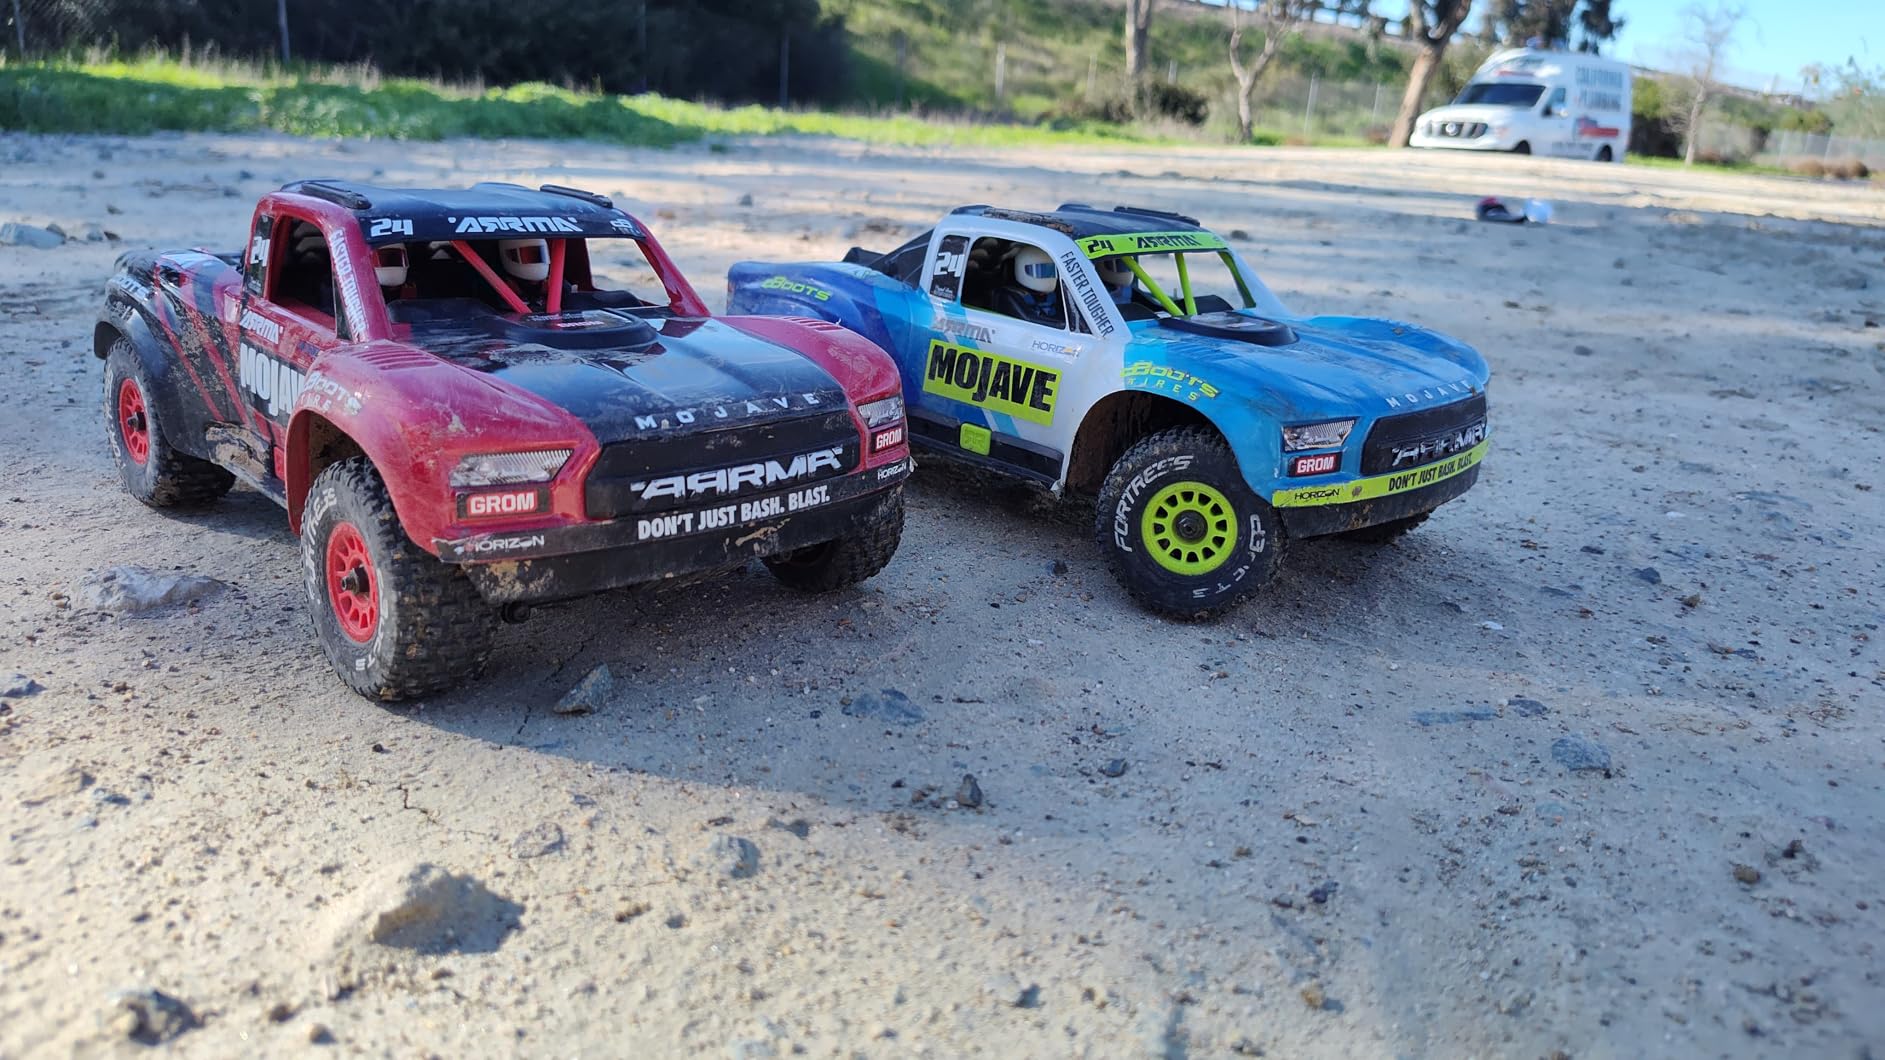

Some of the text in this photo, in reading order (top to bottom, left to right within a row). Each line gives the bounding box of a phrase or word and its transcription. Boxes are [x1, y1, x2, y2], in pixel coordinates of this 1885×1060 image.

[370, 218, 414, 237] 24
[250, 236, 271, 267] 24
[1087, 240, 1115, 253] 24
[934, 251, 965, 277] 24
[240, 342, 306, 416] MOJAV
[928, 344, 1057, 412] MOJAVE
[1128, 377, 1198, 401] TIRES
[634, 393, 820, 430] MOJAVE
[876, 428, 902, 449] GROM
[1296, 456, 1334, 473] GROM
[1388, 472, 1418, 491] DON'T
[1418, 466, 1438, 484] JUST
[470, 492, 534, 514] GROM
[1294, 488, 1340, 500] HORIZON
[638, 485, 830, 540] DON'T JUST BASH. BLAST.
